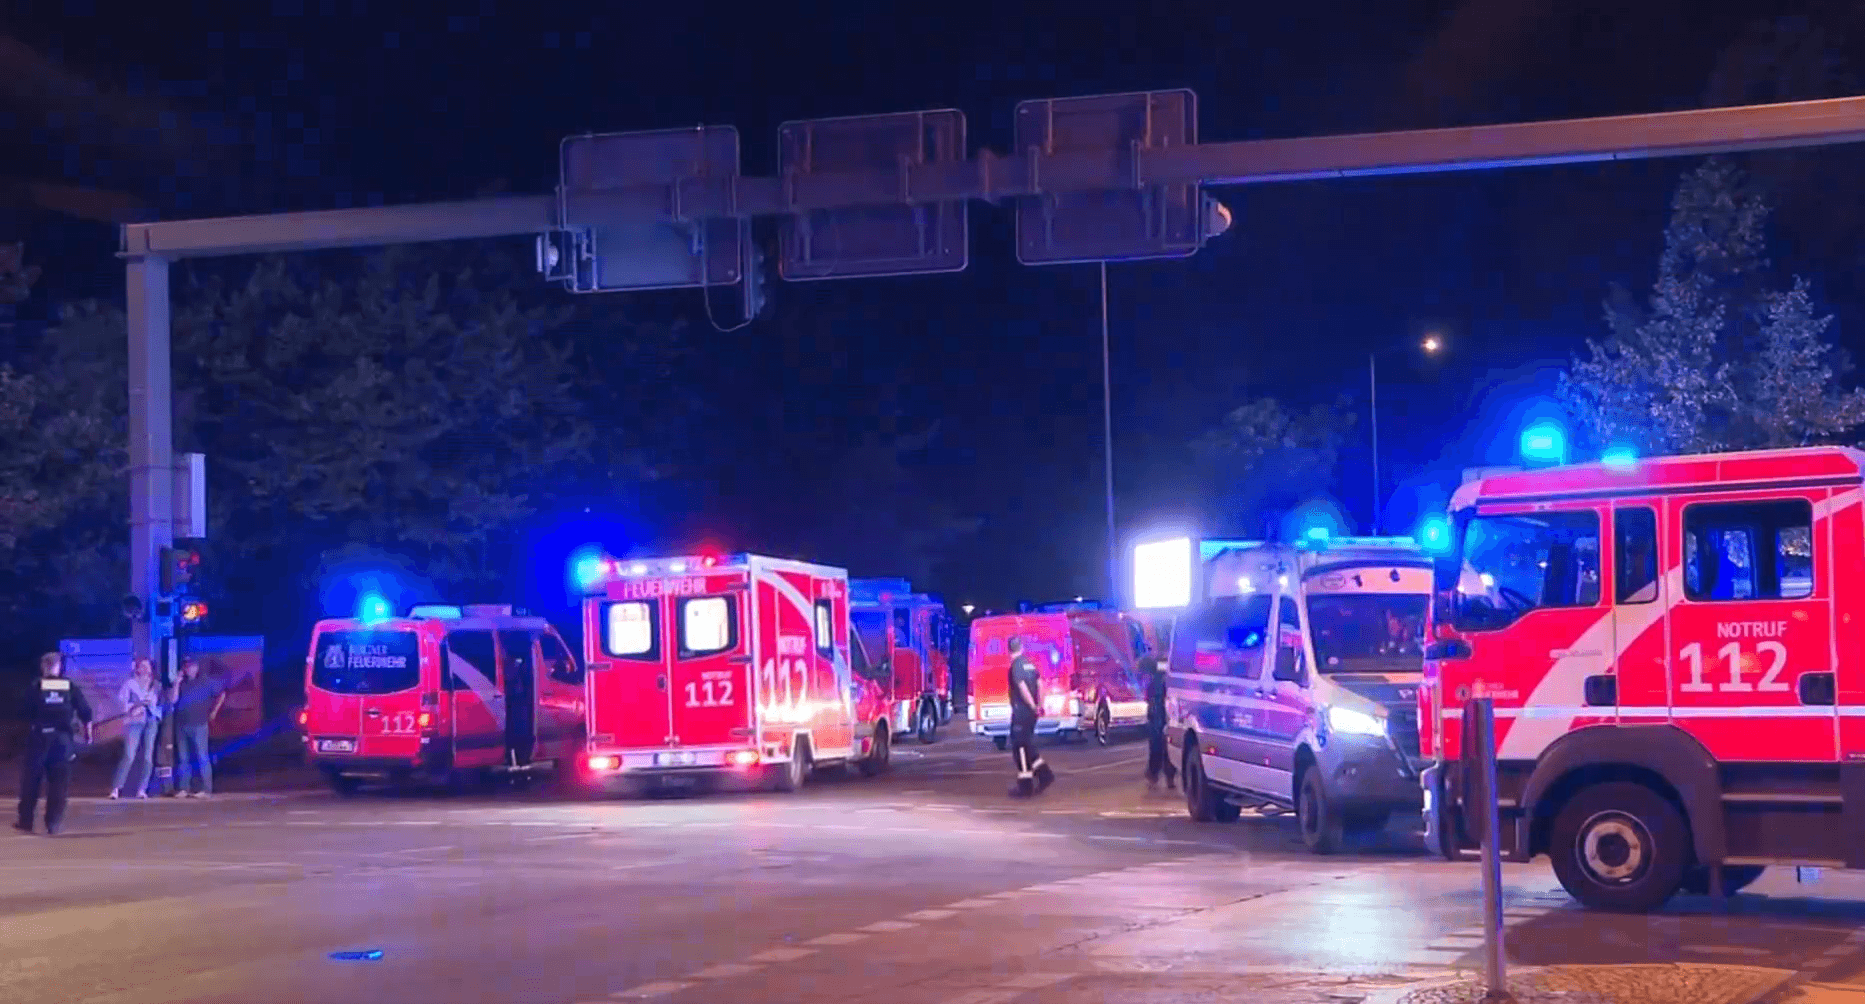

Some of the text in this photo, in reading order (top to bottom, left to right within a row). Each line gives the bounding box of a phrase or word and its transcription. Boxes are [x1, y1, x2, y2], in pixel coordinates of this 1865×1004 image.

[1717, 621, 1787, 638] NOTRUF
[1680, 641, 1789, 692] 112
[685, 681, 734, 708] 112
[380, 714, 416, 735] 112
